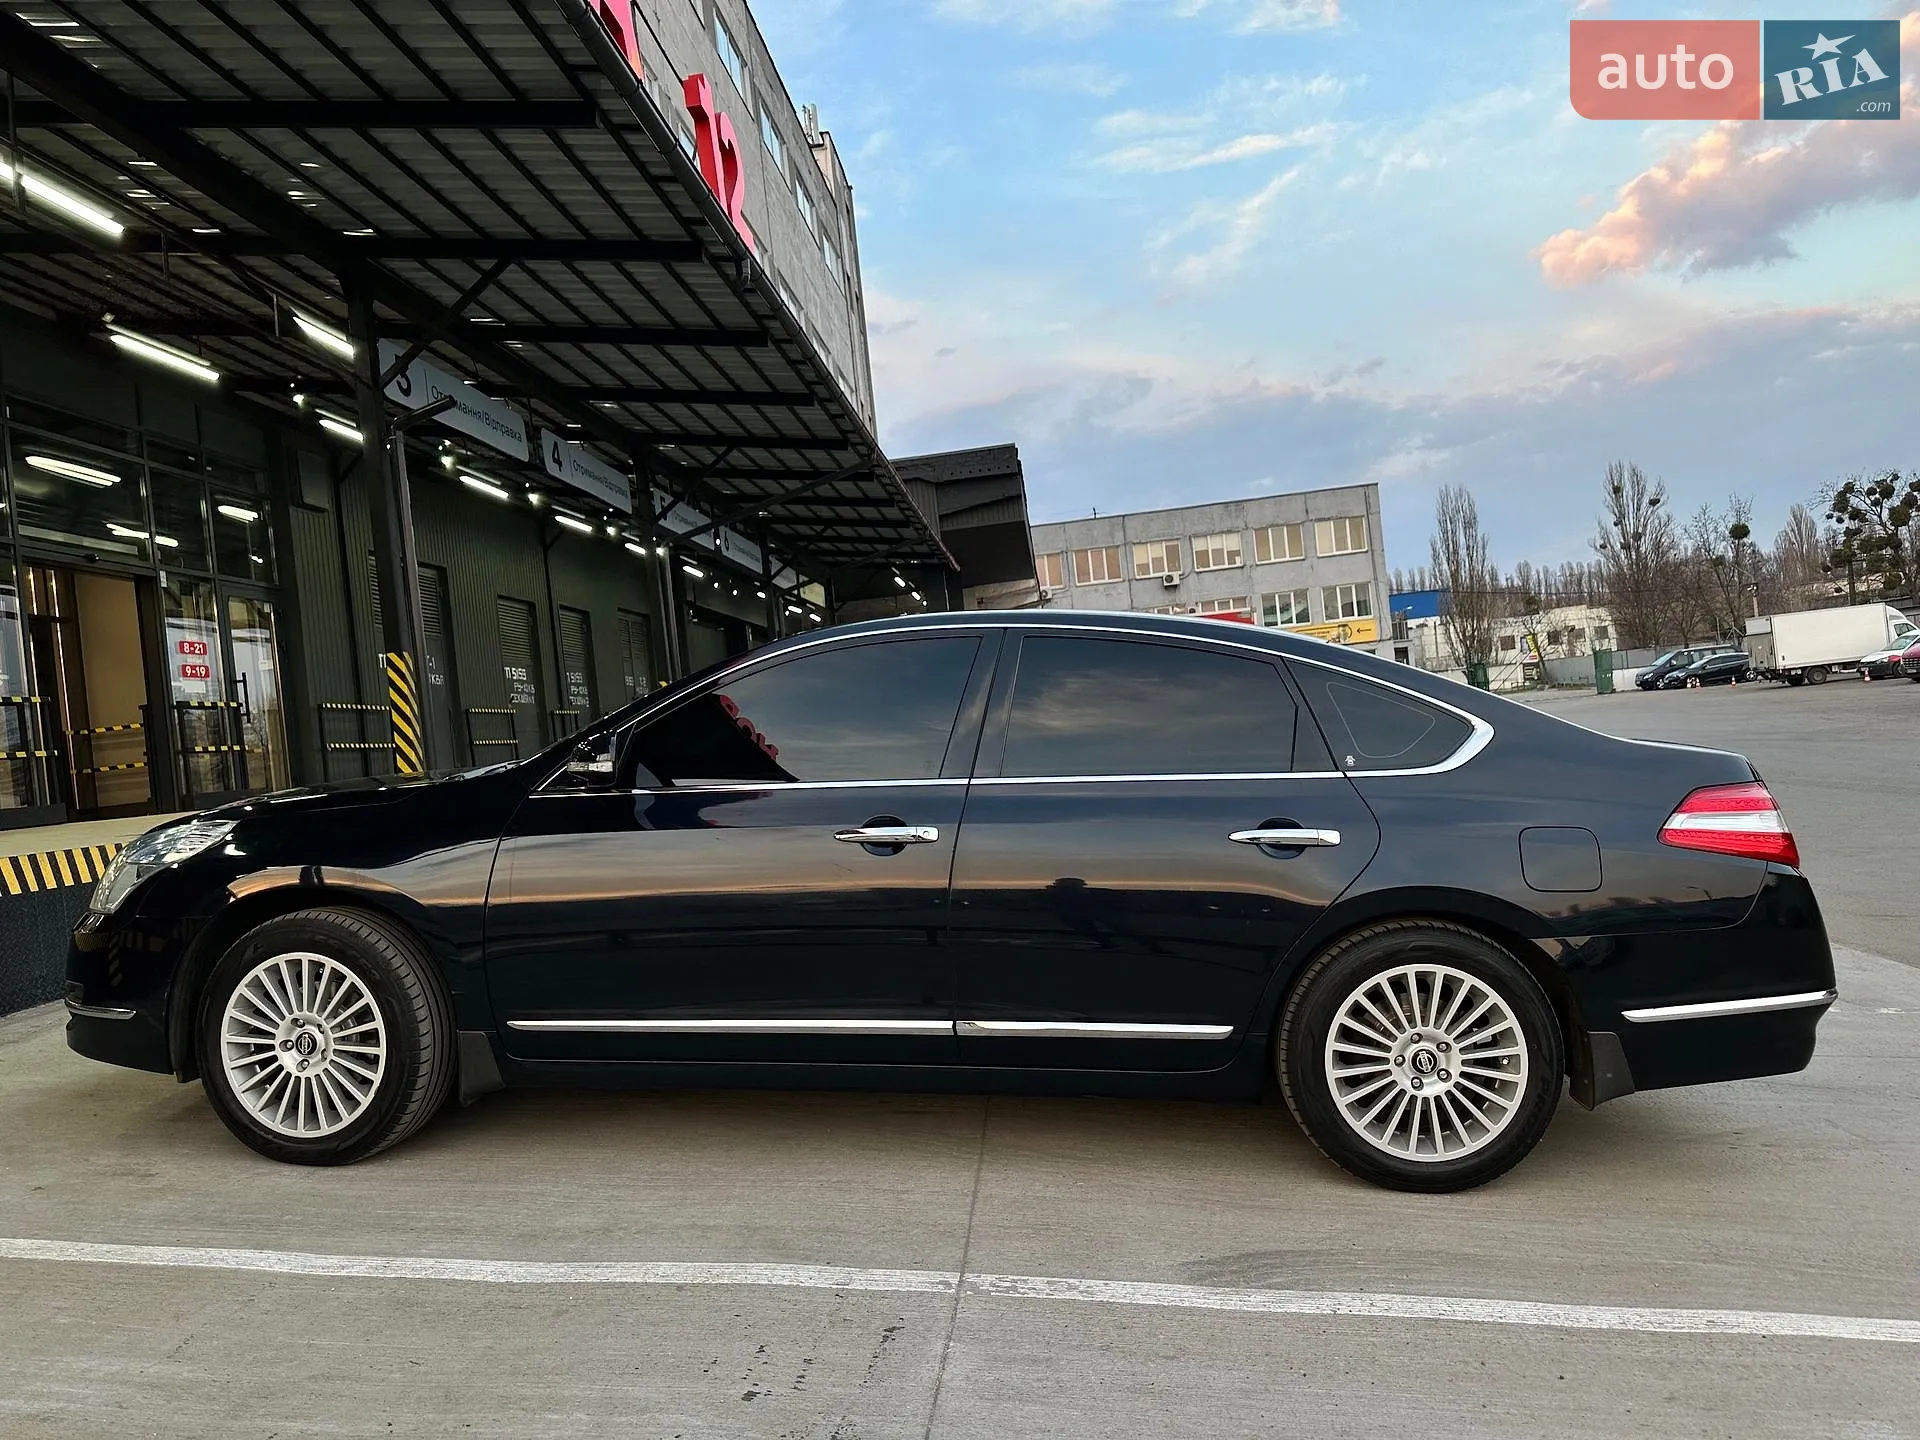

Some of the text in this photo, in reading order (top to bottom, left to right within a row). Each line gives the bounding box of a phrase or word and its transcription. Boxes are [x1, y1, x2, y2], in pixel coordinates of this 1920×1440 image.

[552, 440, 563, 472] 4
[183, 642, 204, 654] 8-21
[185, 665, 206, 677] 9-19
